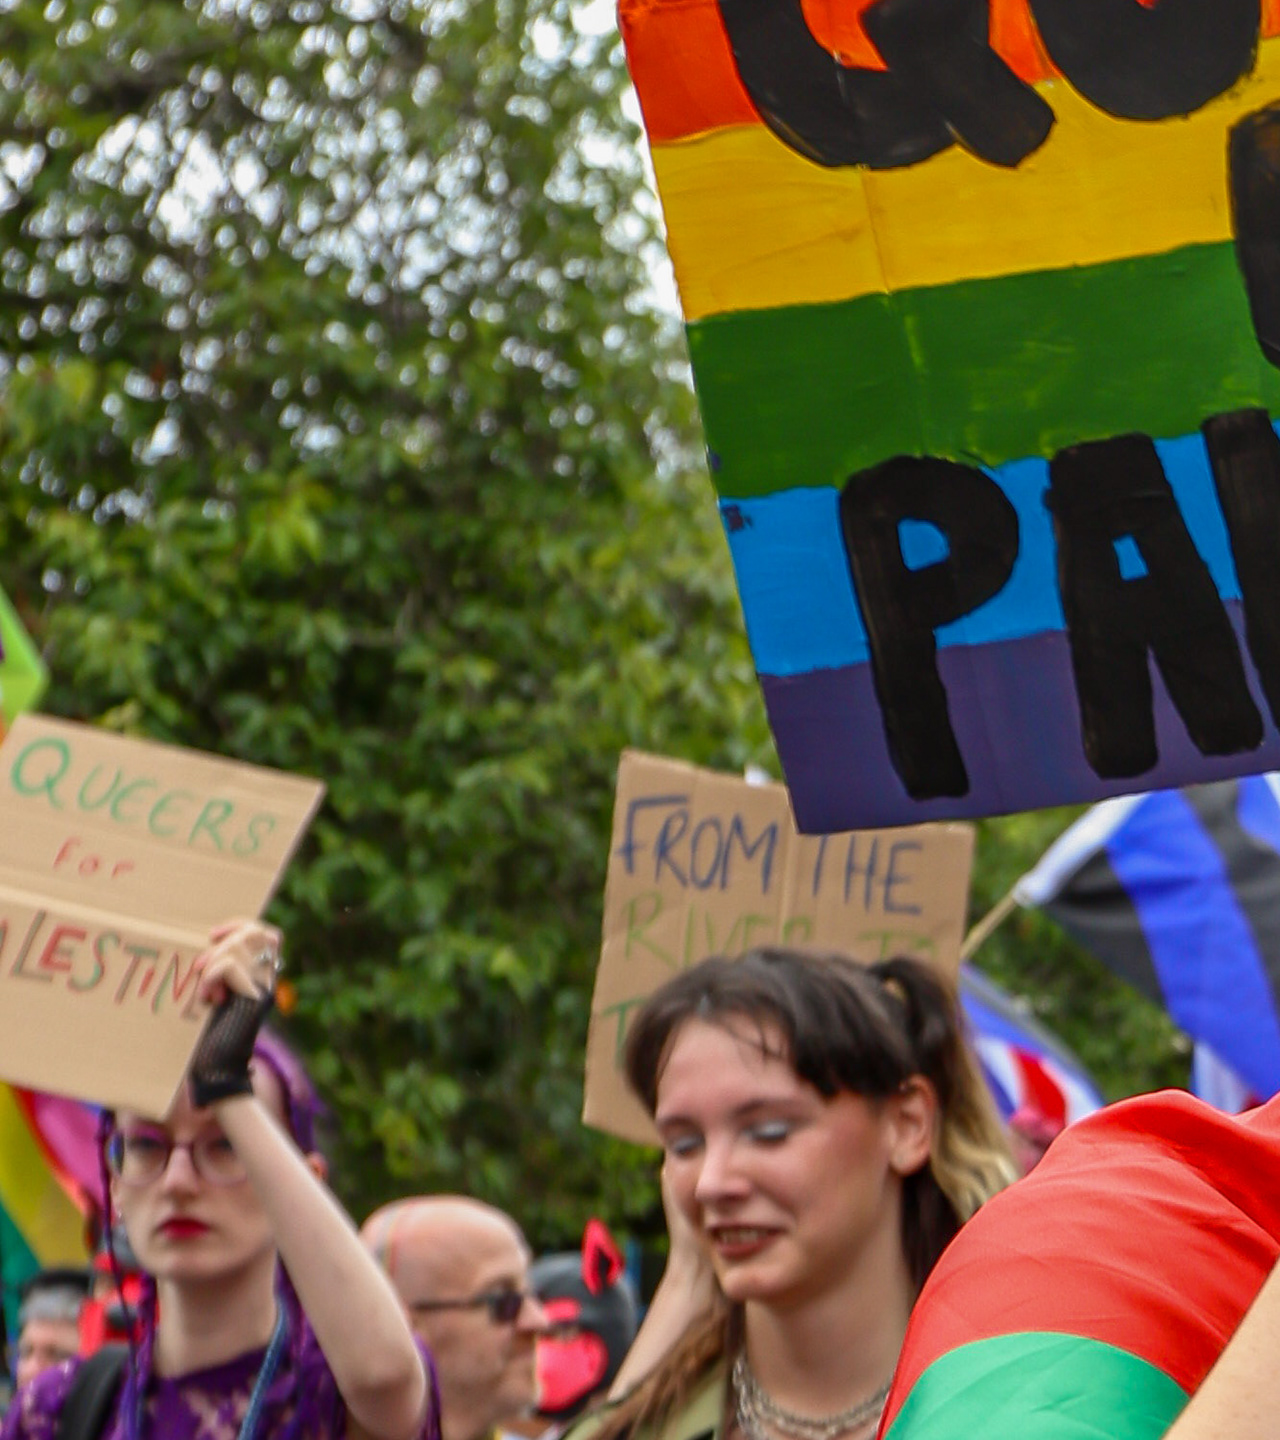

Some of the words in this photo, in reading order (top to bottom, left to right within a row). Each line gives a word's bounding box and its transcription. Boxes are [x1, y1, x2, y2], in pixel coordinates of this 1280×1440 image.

[10, 736, 278, 857] QUEERS
[613, 793, 780, 896] FROM
[802, 831, 924, 916] THE
[0, 908, 206, 1022] LESTIN
